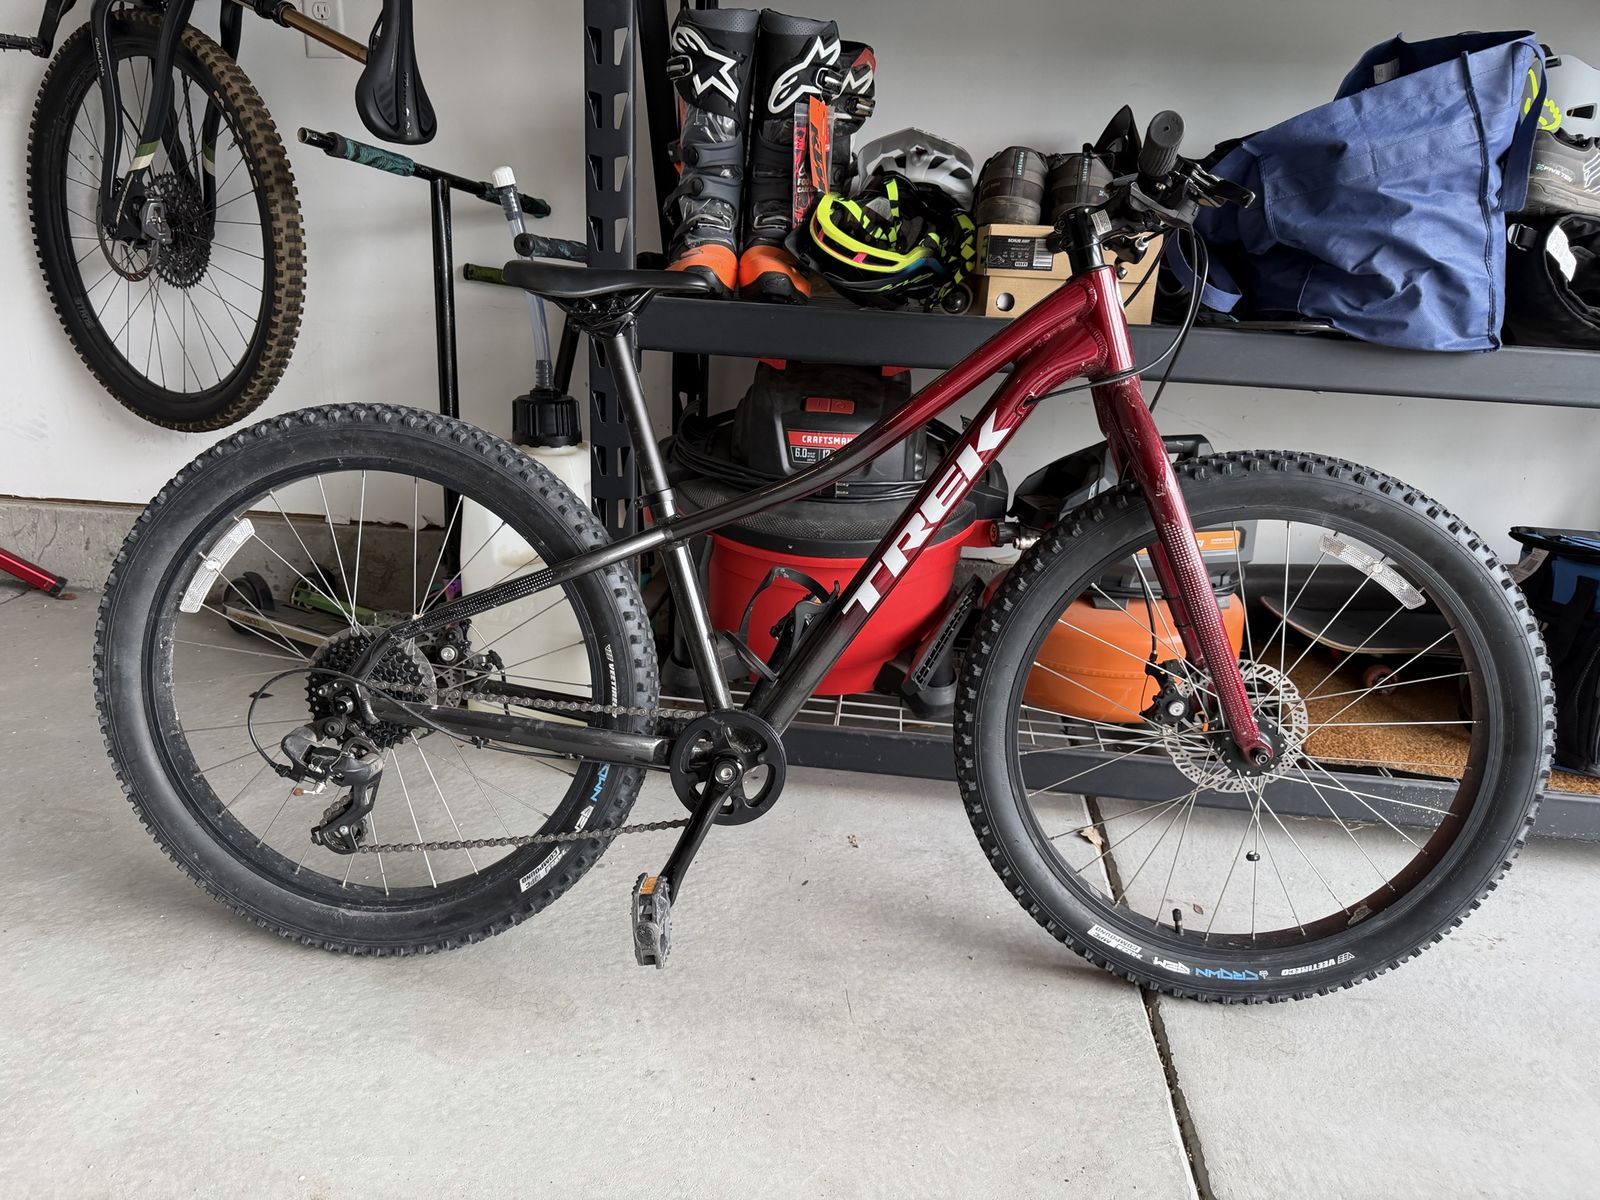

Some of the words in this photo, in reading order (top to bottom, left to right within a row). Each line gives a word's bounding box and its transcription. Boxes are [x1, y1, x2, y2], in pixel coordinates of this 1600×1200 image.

[795, 447, 808, 458] 6.0
[842, 407, 1011, 615] TREK
[590, 763, 610, 803] OWN
[520, 849, 559, 884] COMPOUND
[1094, 926, 1140, 951] COMPOUND
[1194, 966, 1260, 981] CROWN
